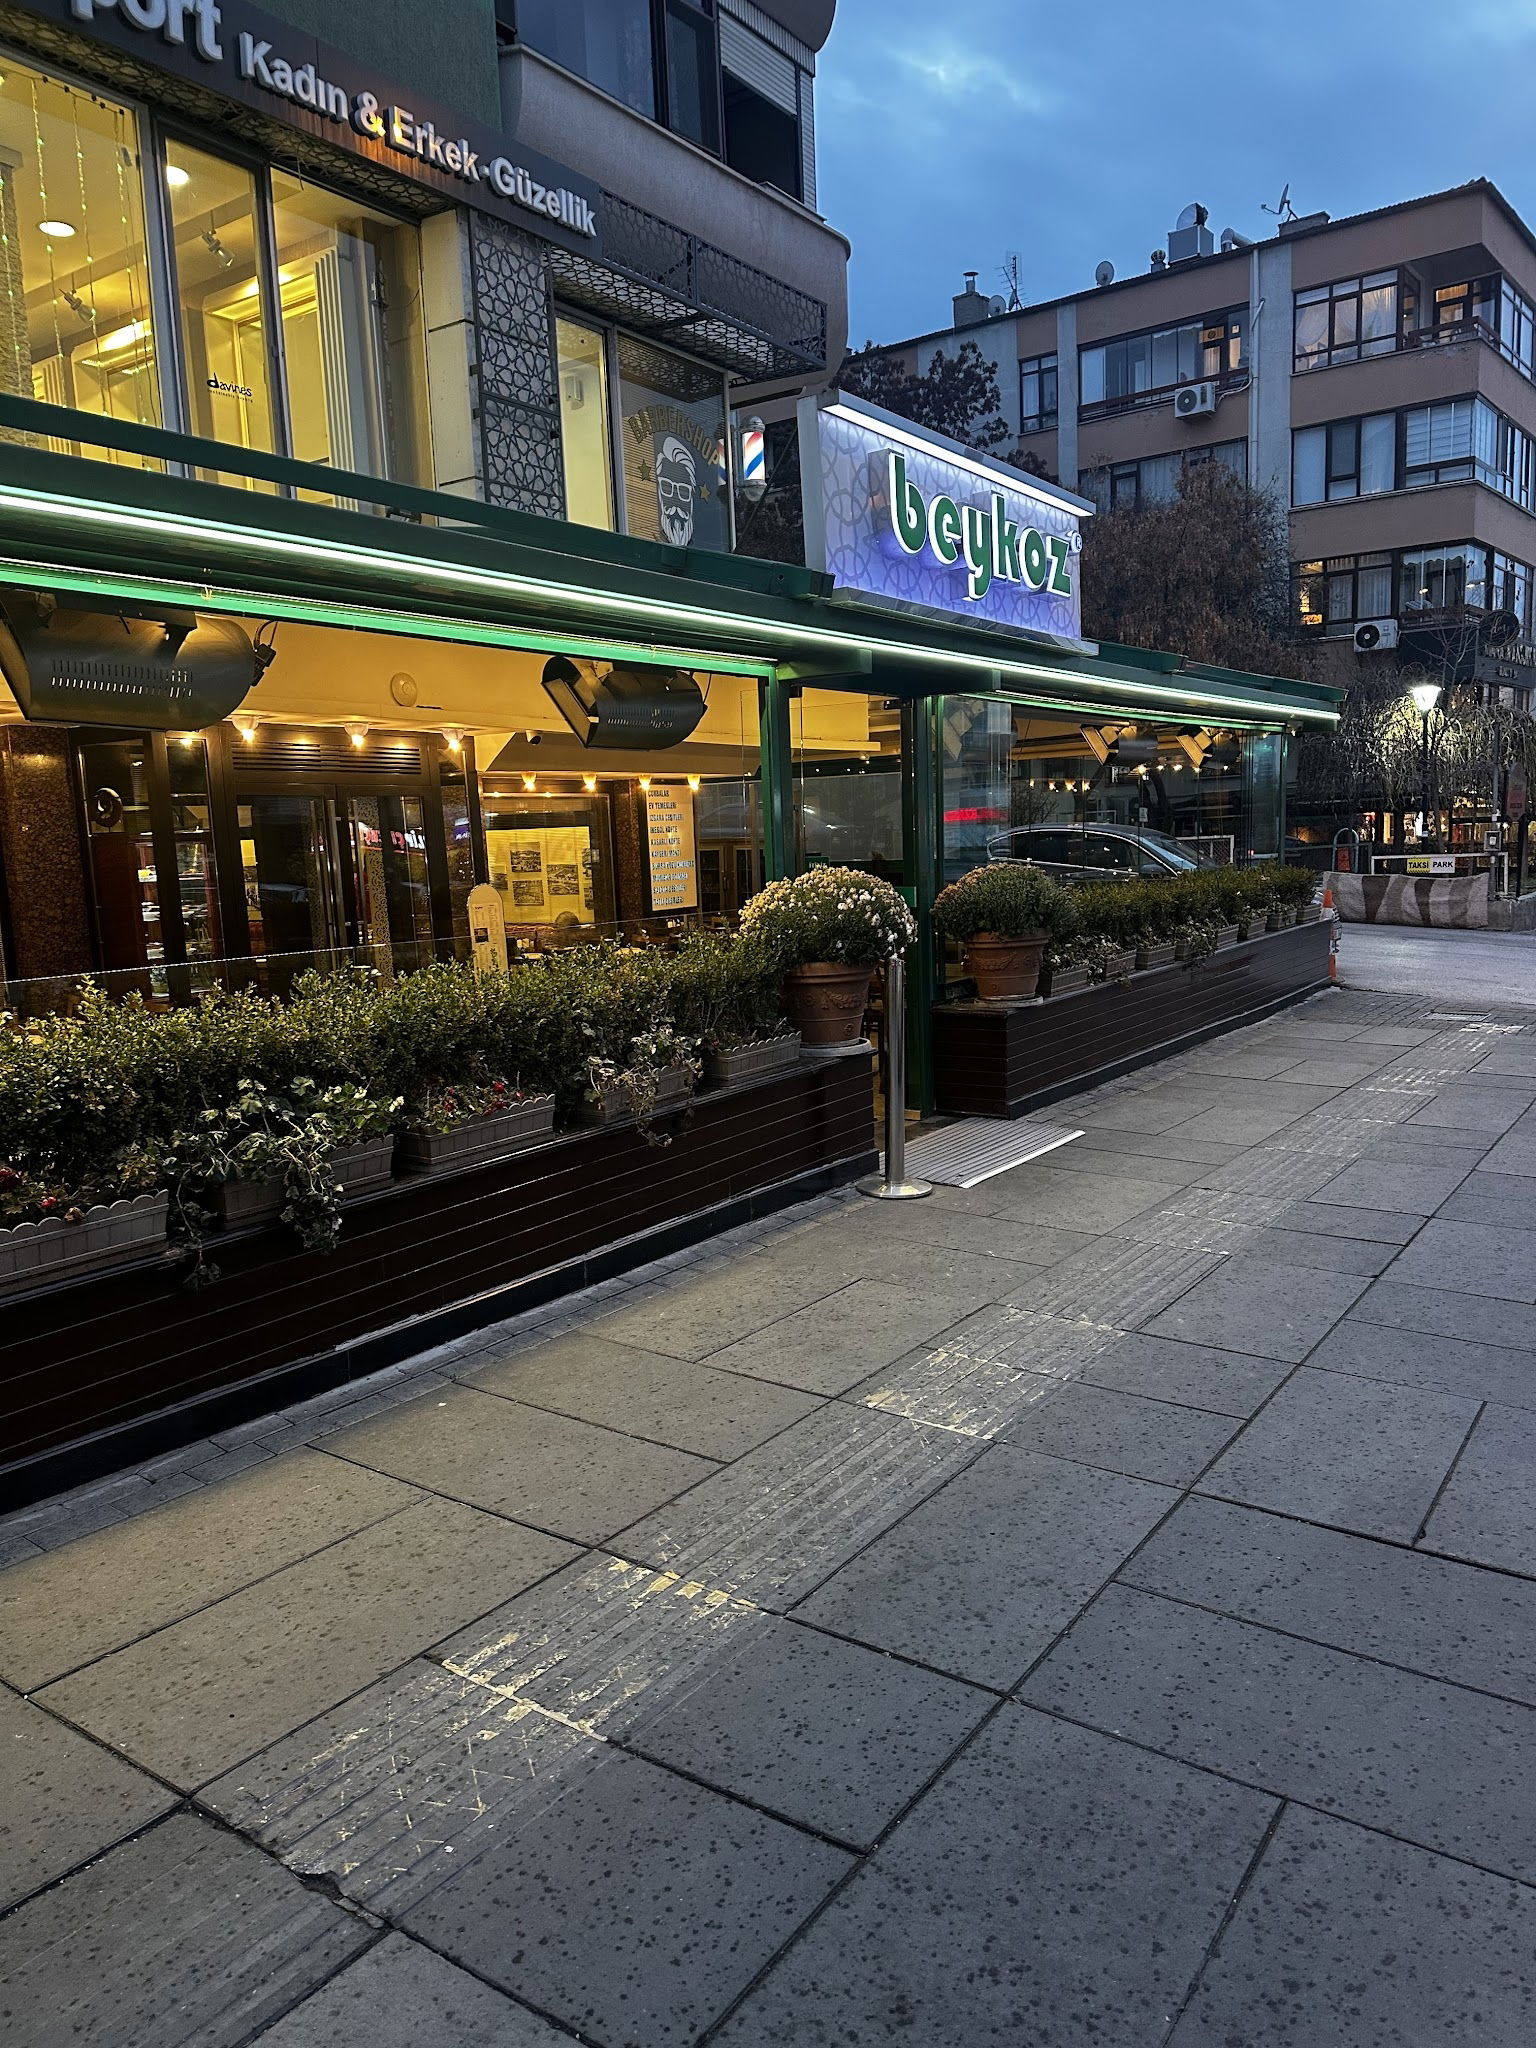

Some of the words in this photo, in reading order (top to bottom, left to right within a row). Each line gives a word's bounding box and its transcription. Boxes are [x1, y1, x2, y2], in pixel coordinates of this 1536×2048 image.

[71, 0, 223, 60] ort
[239, 31, 348, 122] Kadın
[353, 90, 386, 138] &
[207, 372, 252, 396] davines
[628, 404, 720, 466] BARBERSHOP
[888, 452, 1072, 600] beykoz
